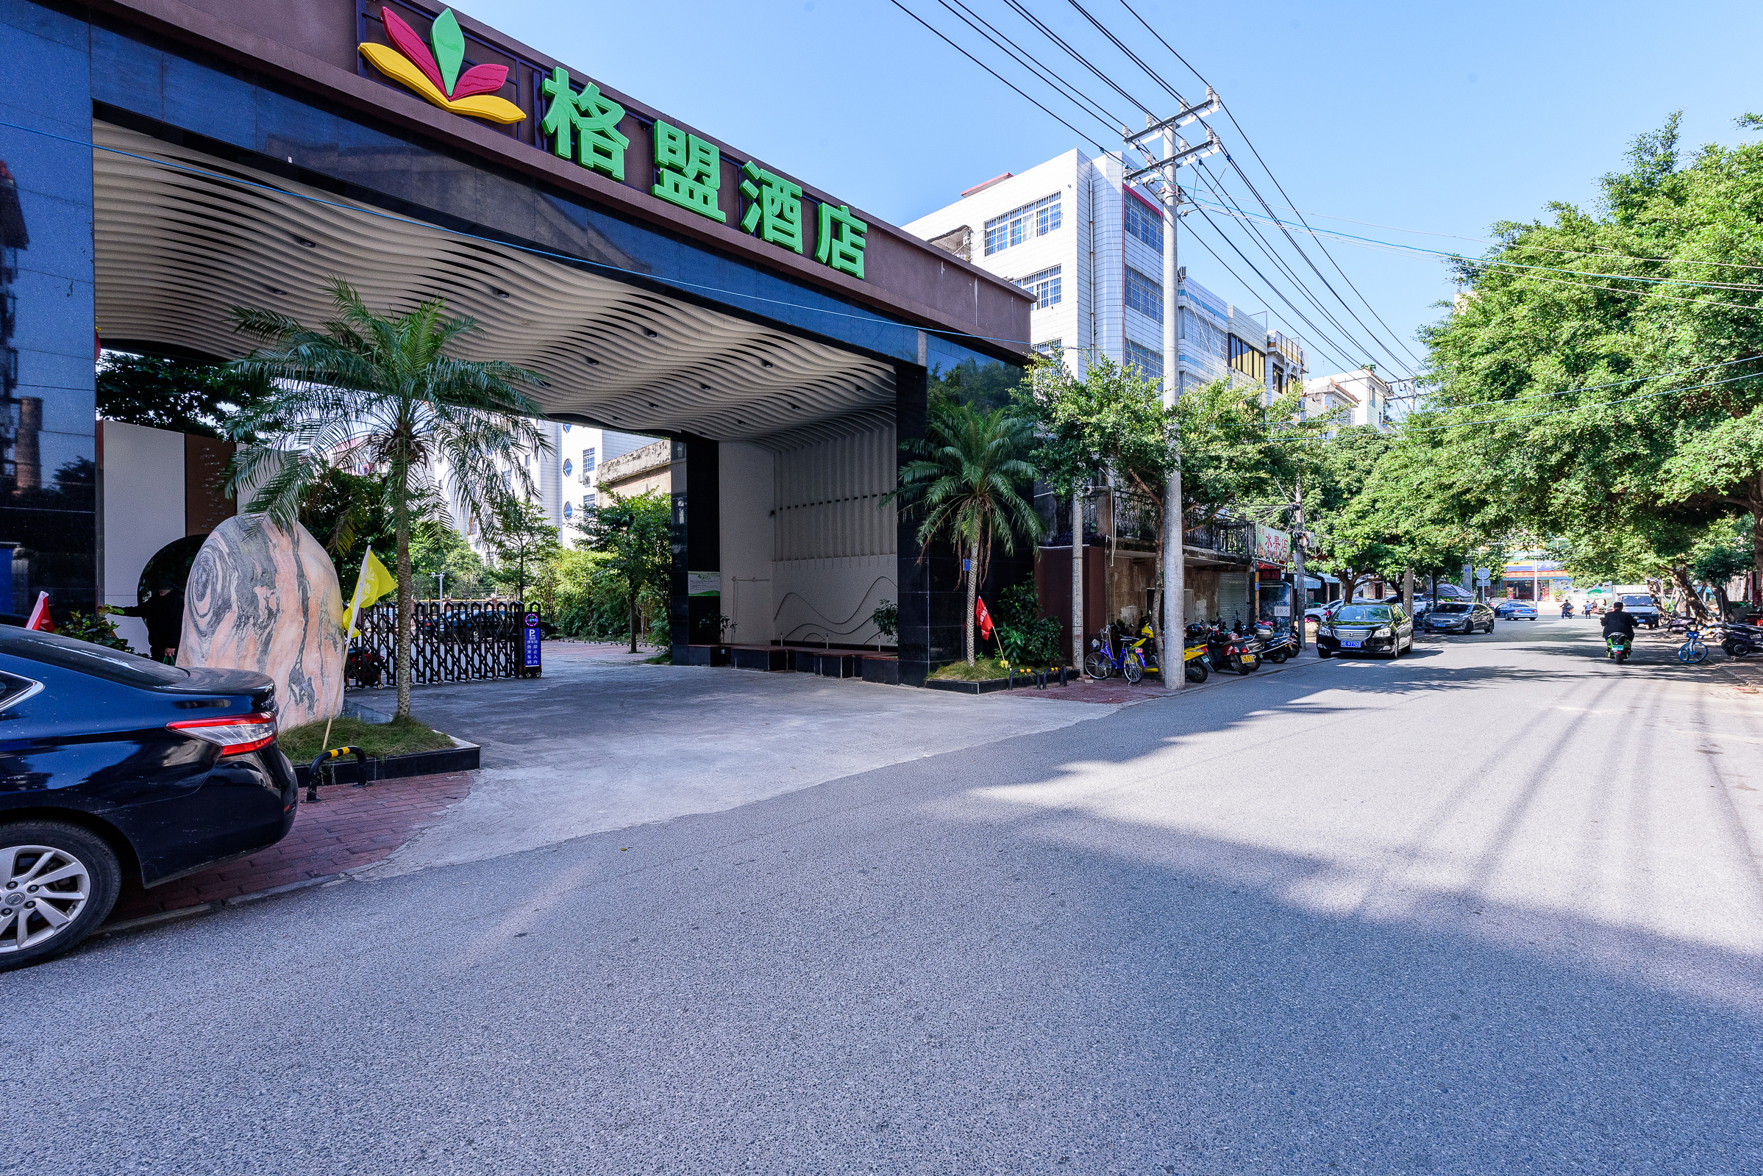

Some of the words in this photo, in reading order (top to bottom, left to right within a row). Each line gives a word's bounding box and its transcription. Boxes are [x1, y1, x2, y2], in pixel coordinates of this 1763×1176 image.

[542, 66, 867, 279] 格盟酒店
[1264, 533, 1289, 554] 水果店
